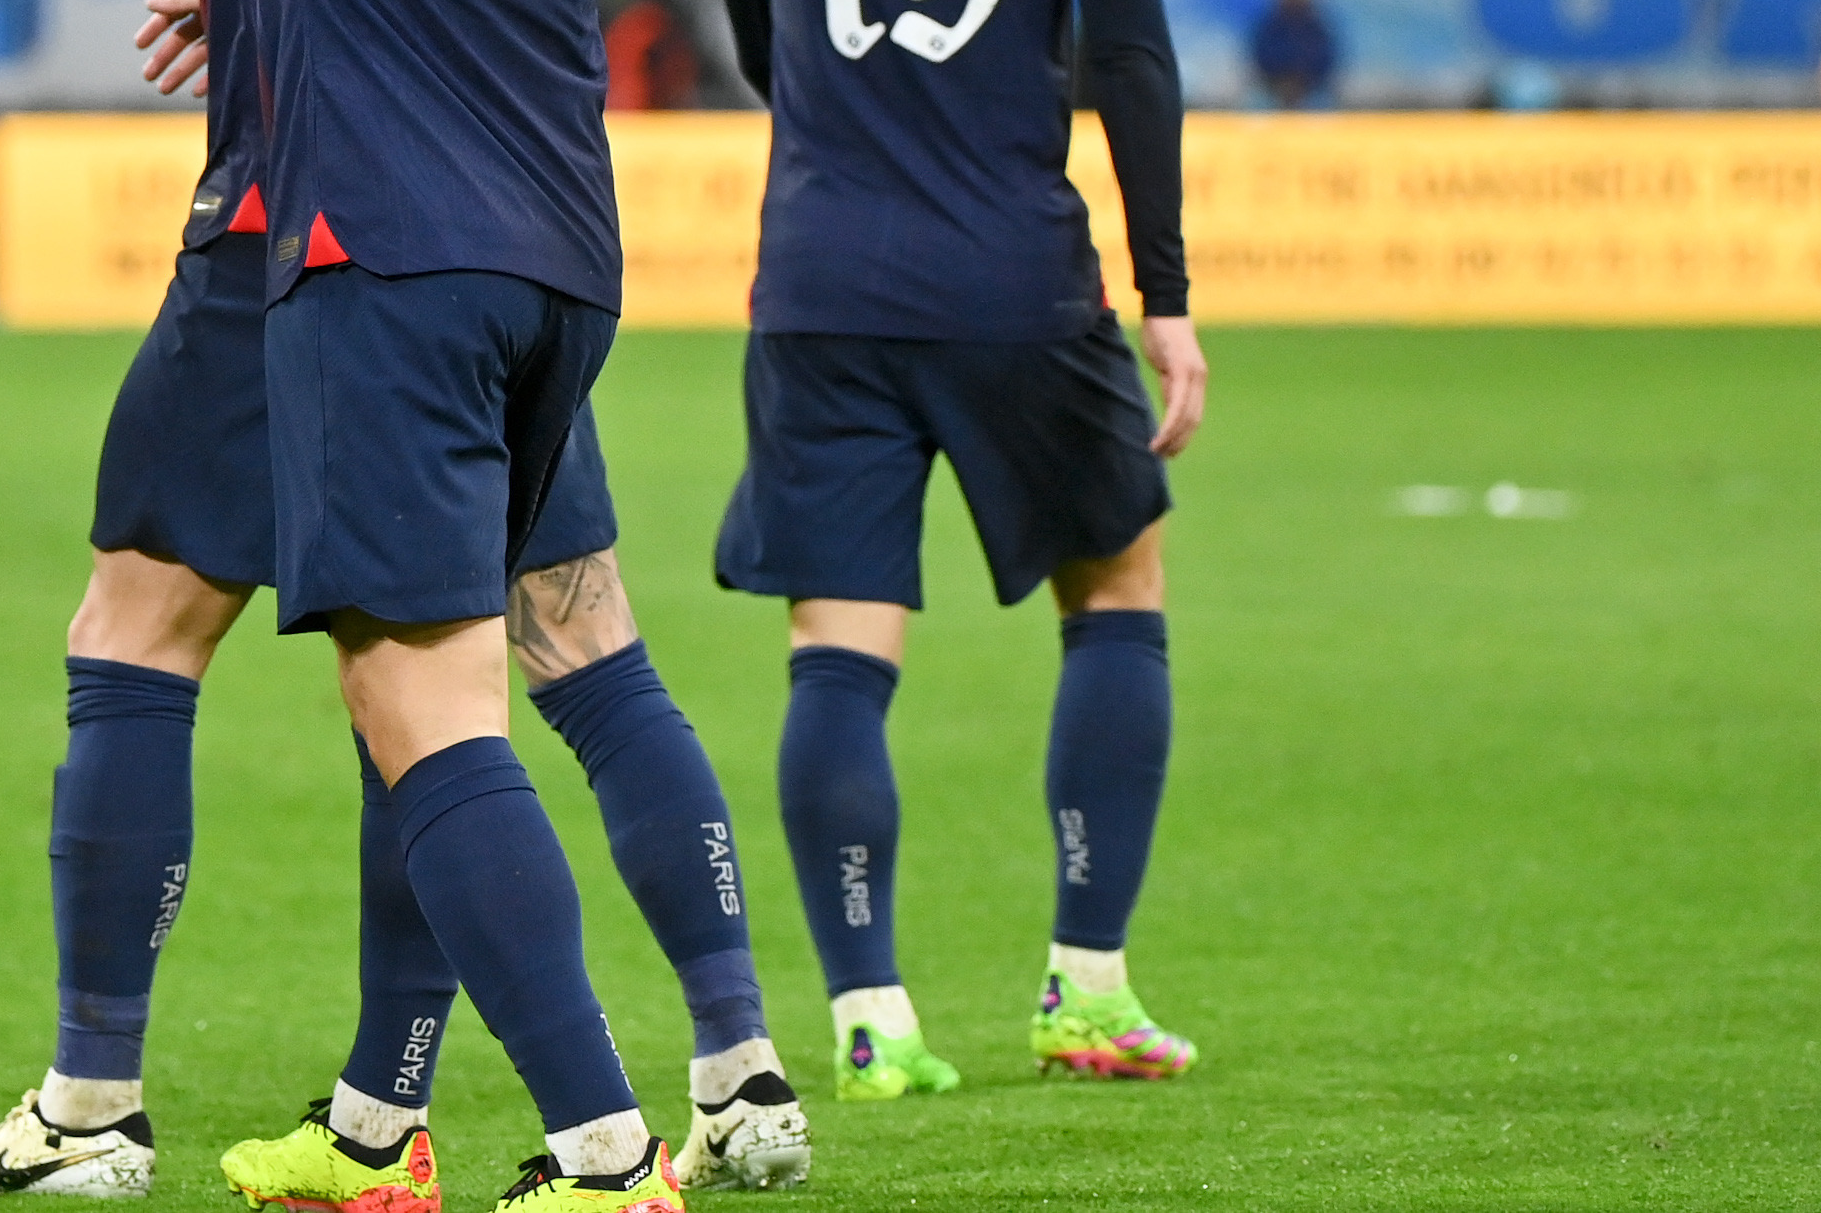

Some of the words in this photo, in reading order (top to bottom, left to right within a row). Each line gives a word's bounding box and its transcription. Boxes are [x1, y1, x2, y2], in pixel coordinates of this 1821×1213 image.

[699, 822, 741, 916] PARIS
[838, 845, 872, 928] PARIS
[393, 1017, 436, 1095] PARIS
